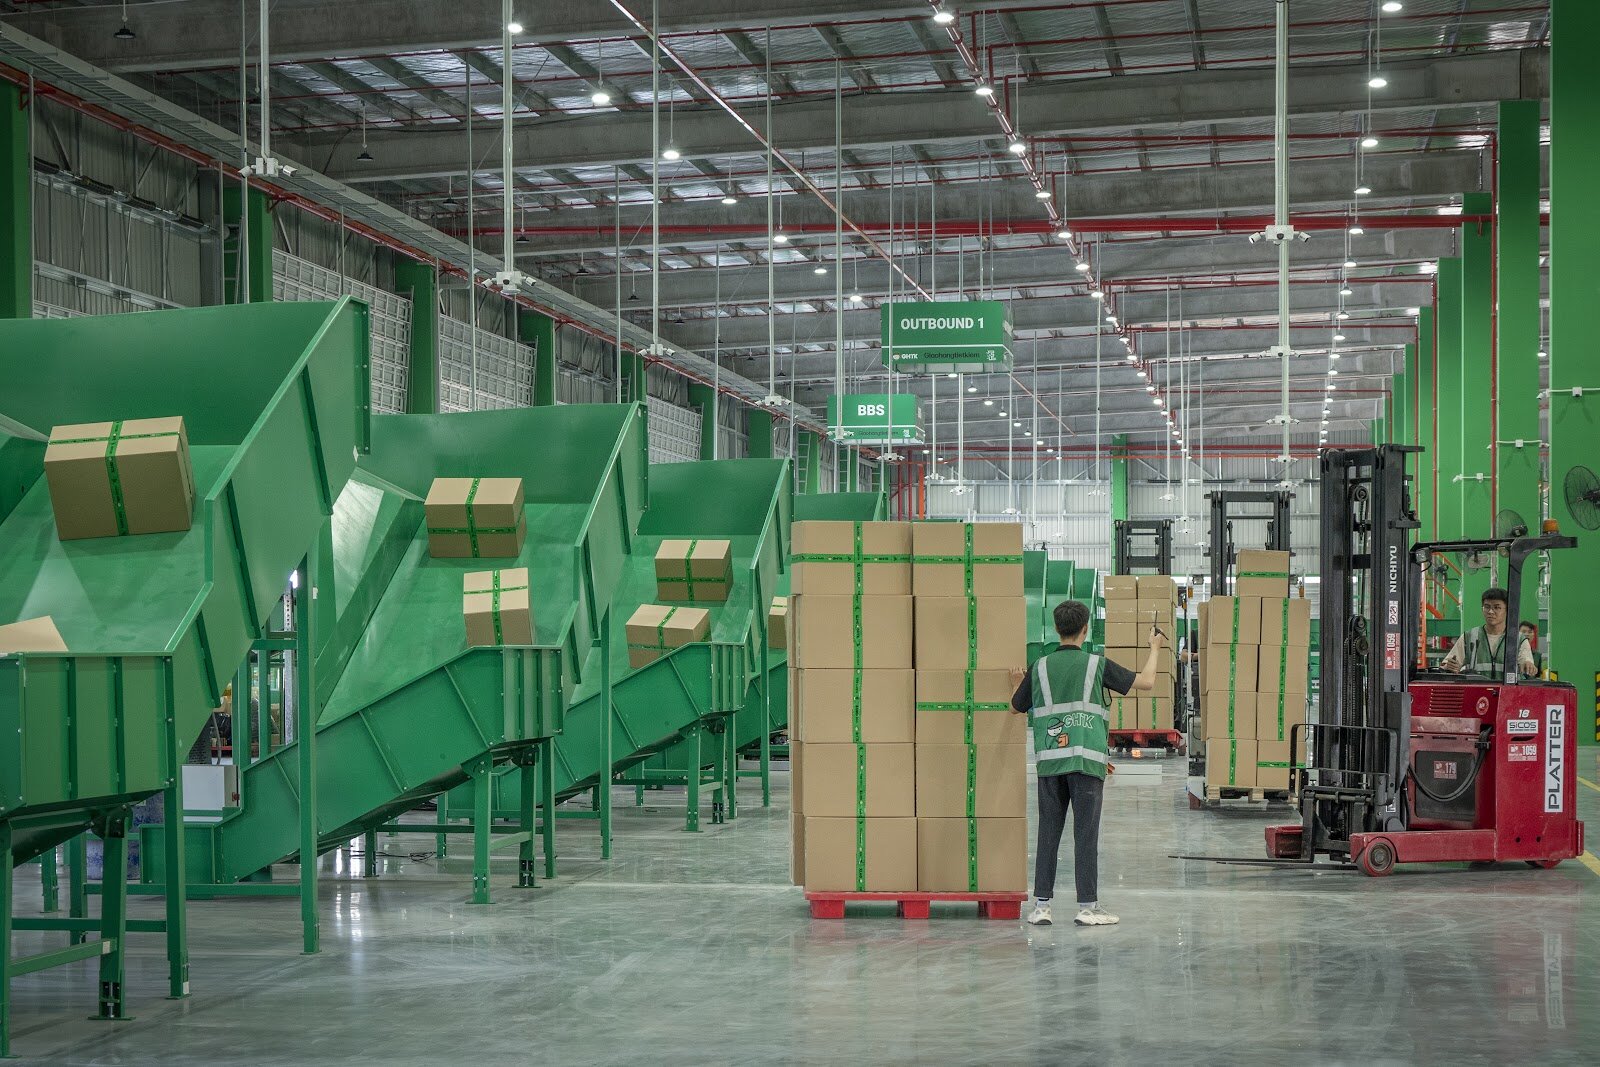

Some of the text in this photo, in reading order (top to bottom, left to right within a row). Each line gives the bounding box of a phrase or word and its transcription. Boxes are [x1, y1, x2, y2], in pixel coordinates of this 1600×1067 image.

[900, 317, 984, 330] OUTBOUND 1
[857, 404, 885, 416] BBS
[1389, 545, 1397, 593] NICHIYU
[1387, 633, 1396, 651] 1059
[1521, 745, 1537, 756] 1059
[1548, 708, 1562, 809] PLATTER
